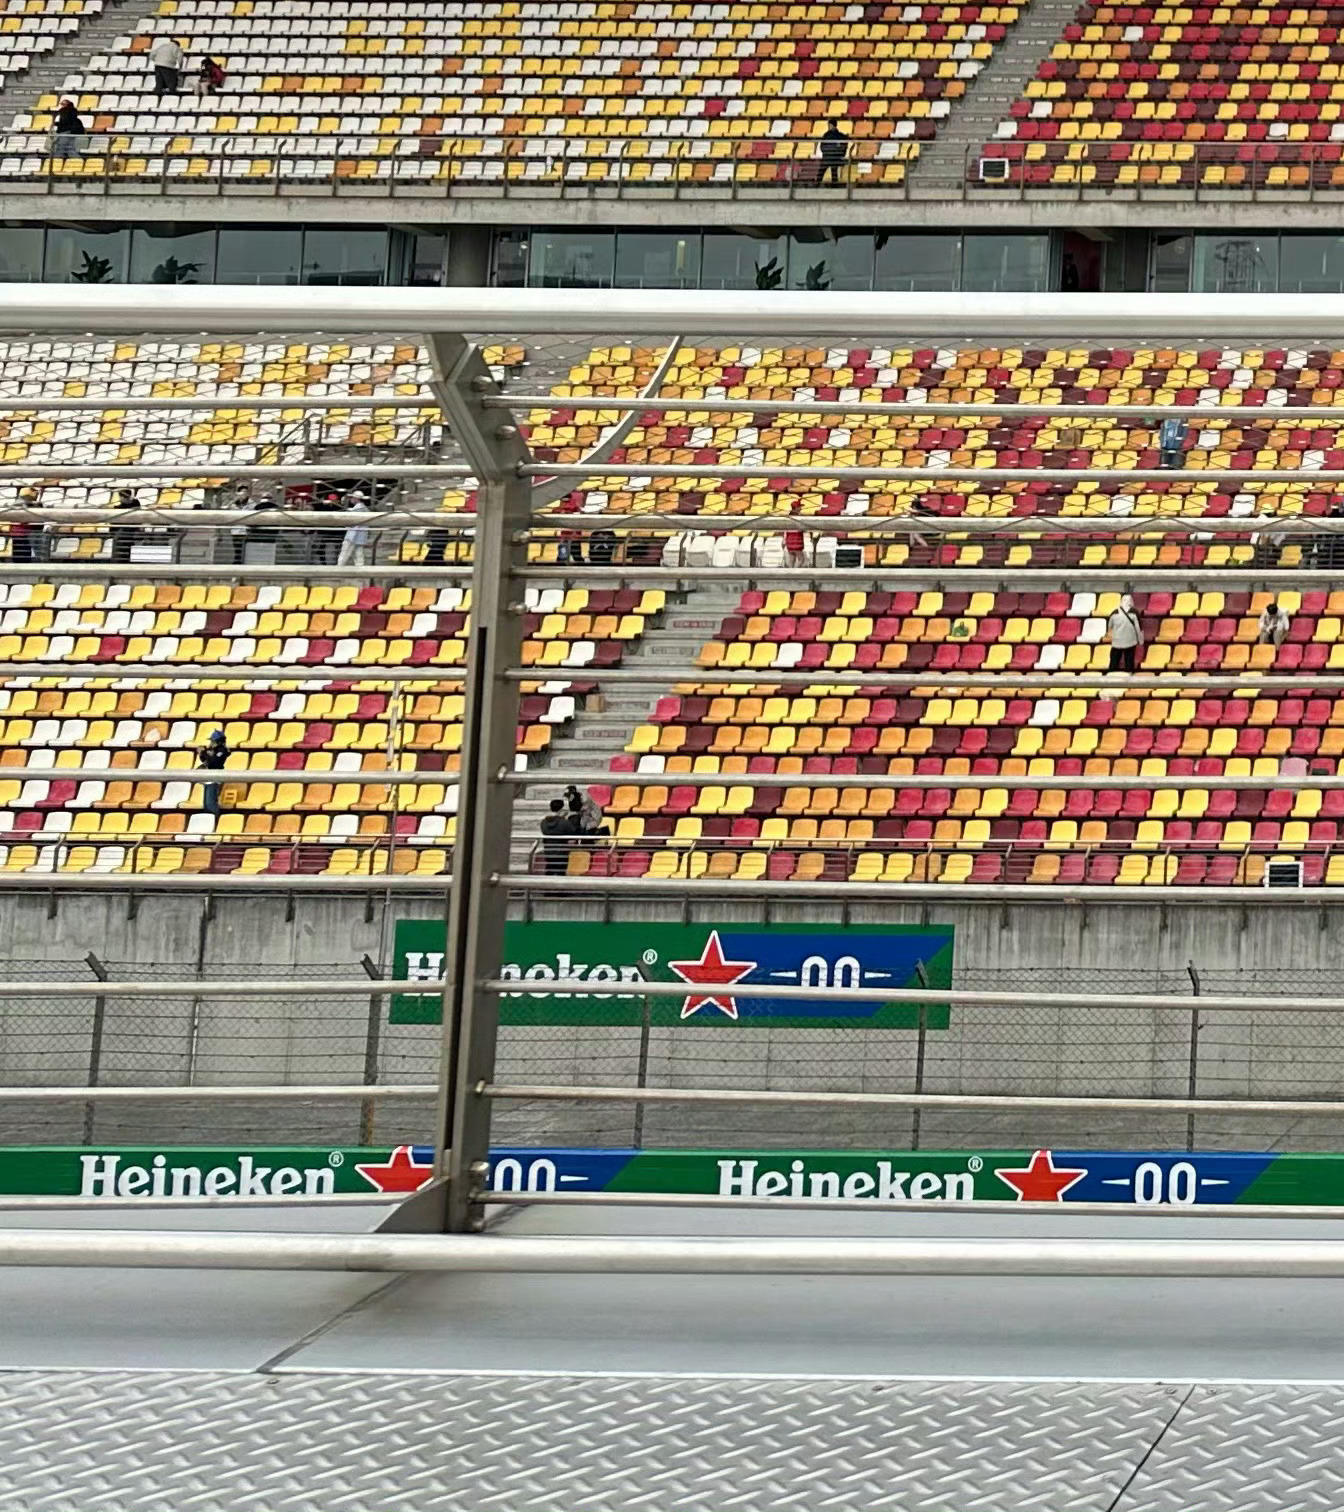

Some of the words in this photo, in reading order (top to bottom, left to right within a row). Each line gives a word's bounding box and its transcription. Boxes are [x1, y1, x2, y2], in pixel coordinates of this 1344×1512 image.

[402, 952, 646, 998] Hneken
[79, 1155, 335, 1197] Heineken
[717, 1159, 975, 1200] Heineken
